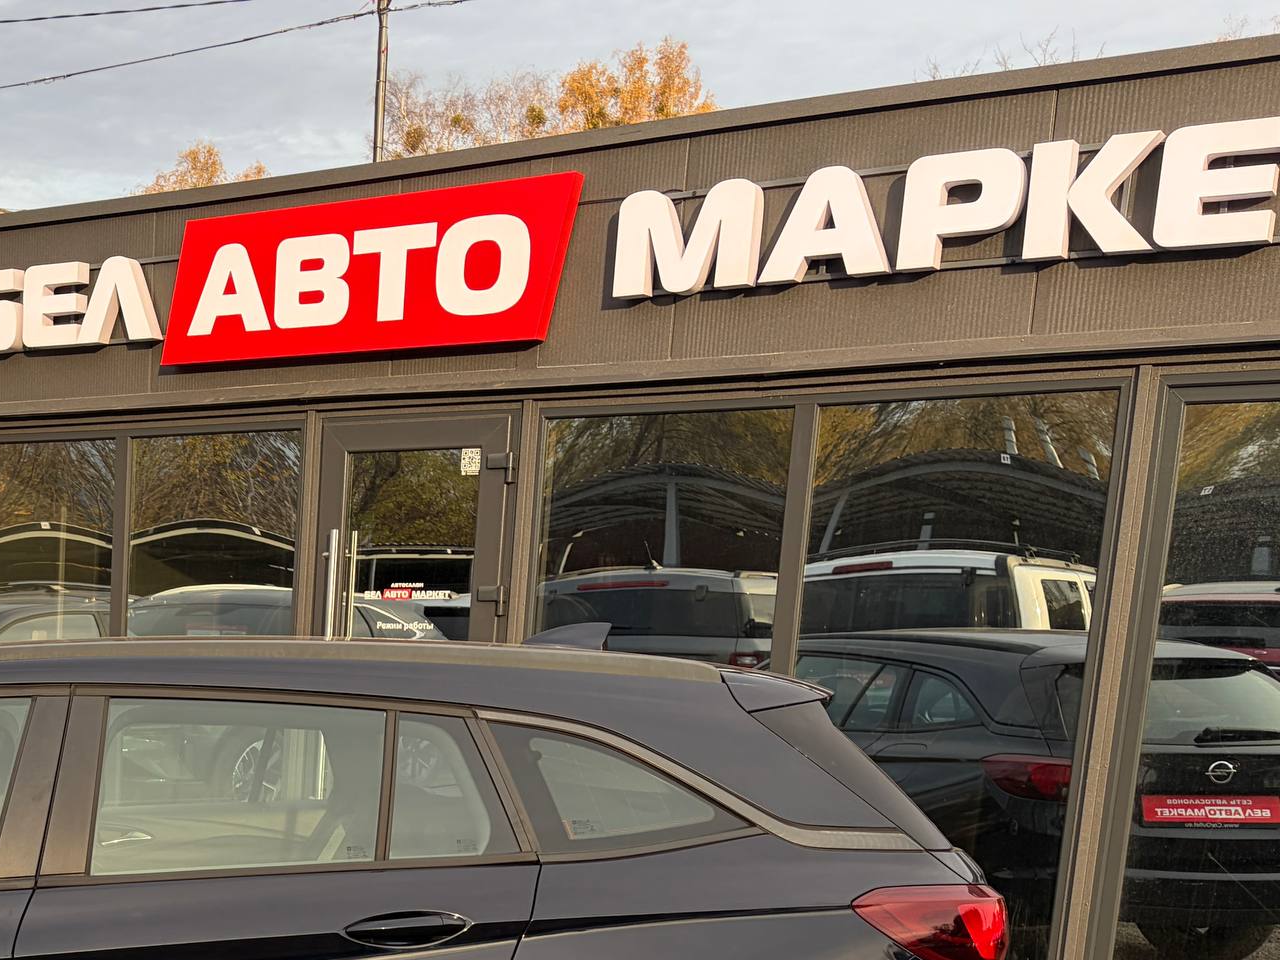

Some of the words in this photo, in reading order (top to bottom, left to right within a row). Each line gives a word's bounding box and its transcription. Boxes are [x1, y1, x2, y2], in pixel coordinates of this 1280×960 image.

[186, 214, 531, 336] АВТО
[613, 117, 1280, 298] МАРКЕ
[364, 590, 381, 599] БЕЛ
[384, 590, 409, 598] АВТО
[411, 590, 451, 600] МАРКЕТ
[403, 620, 434, 631] работы
